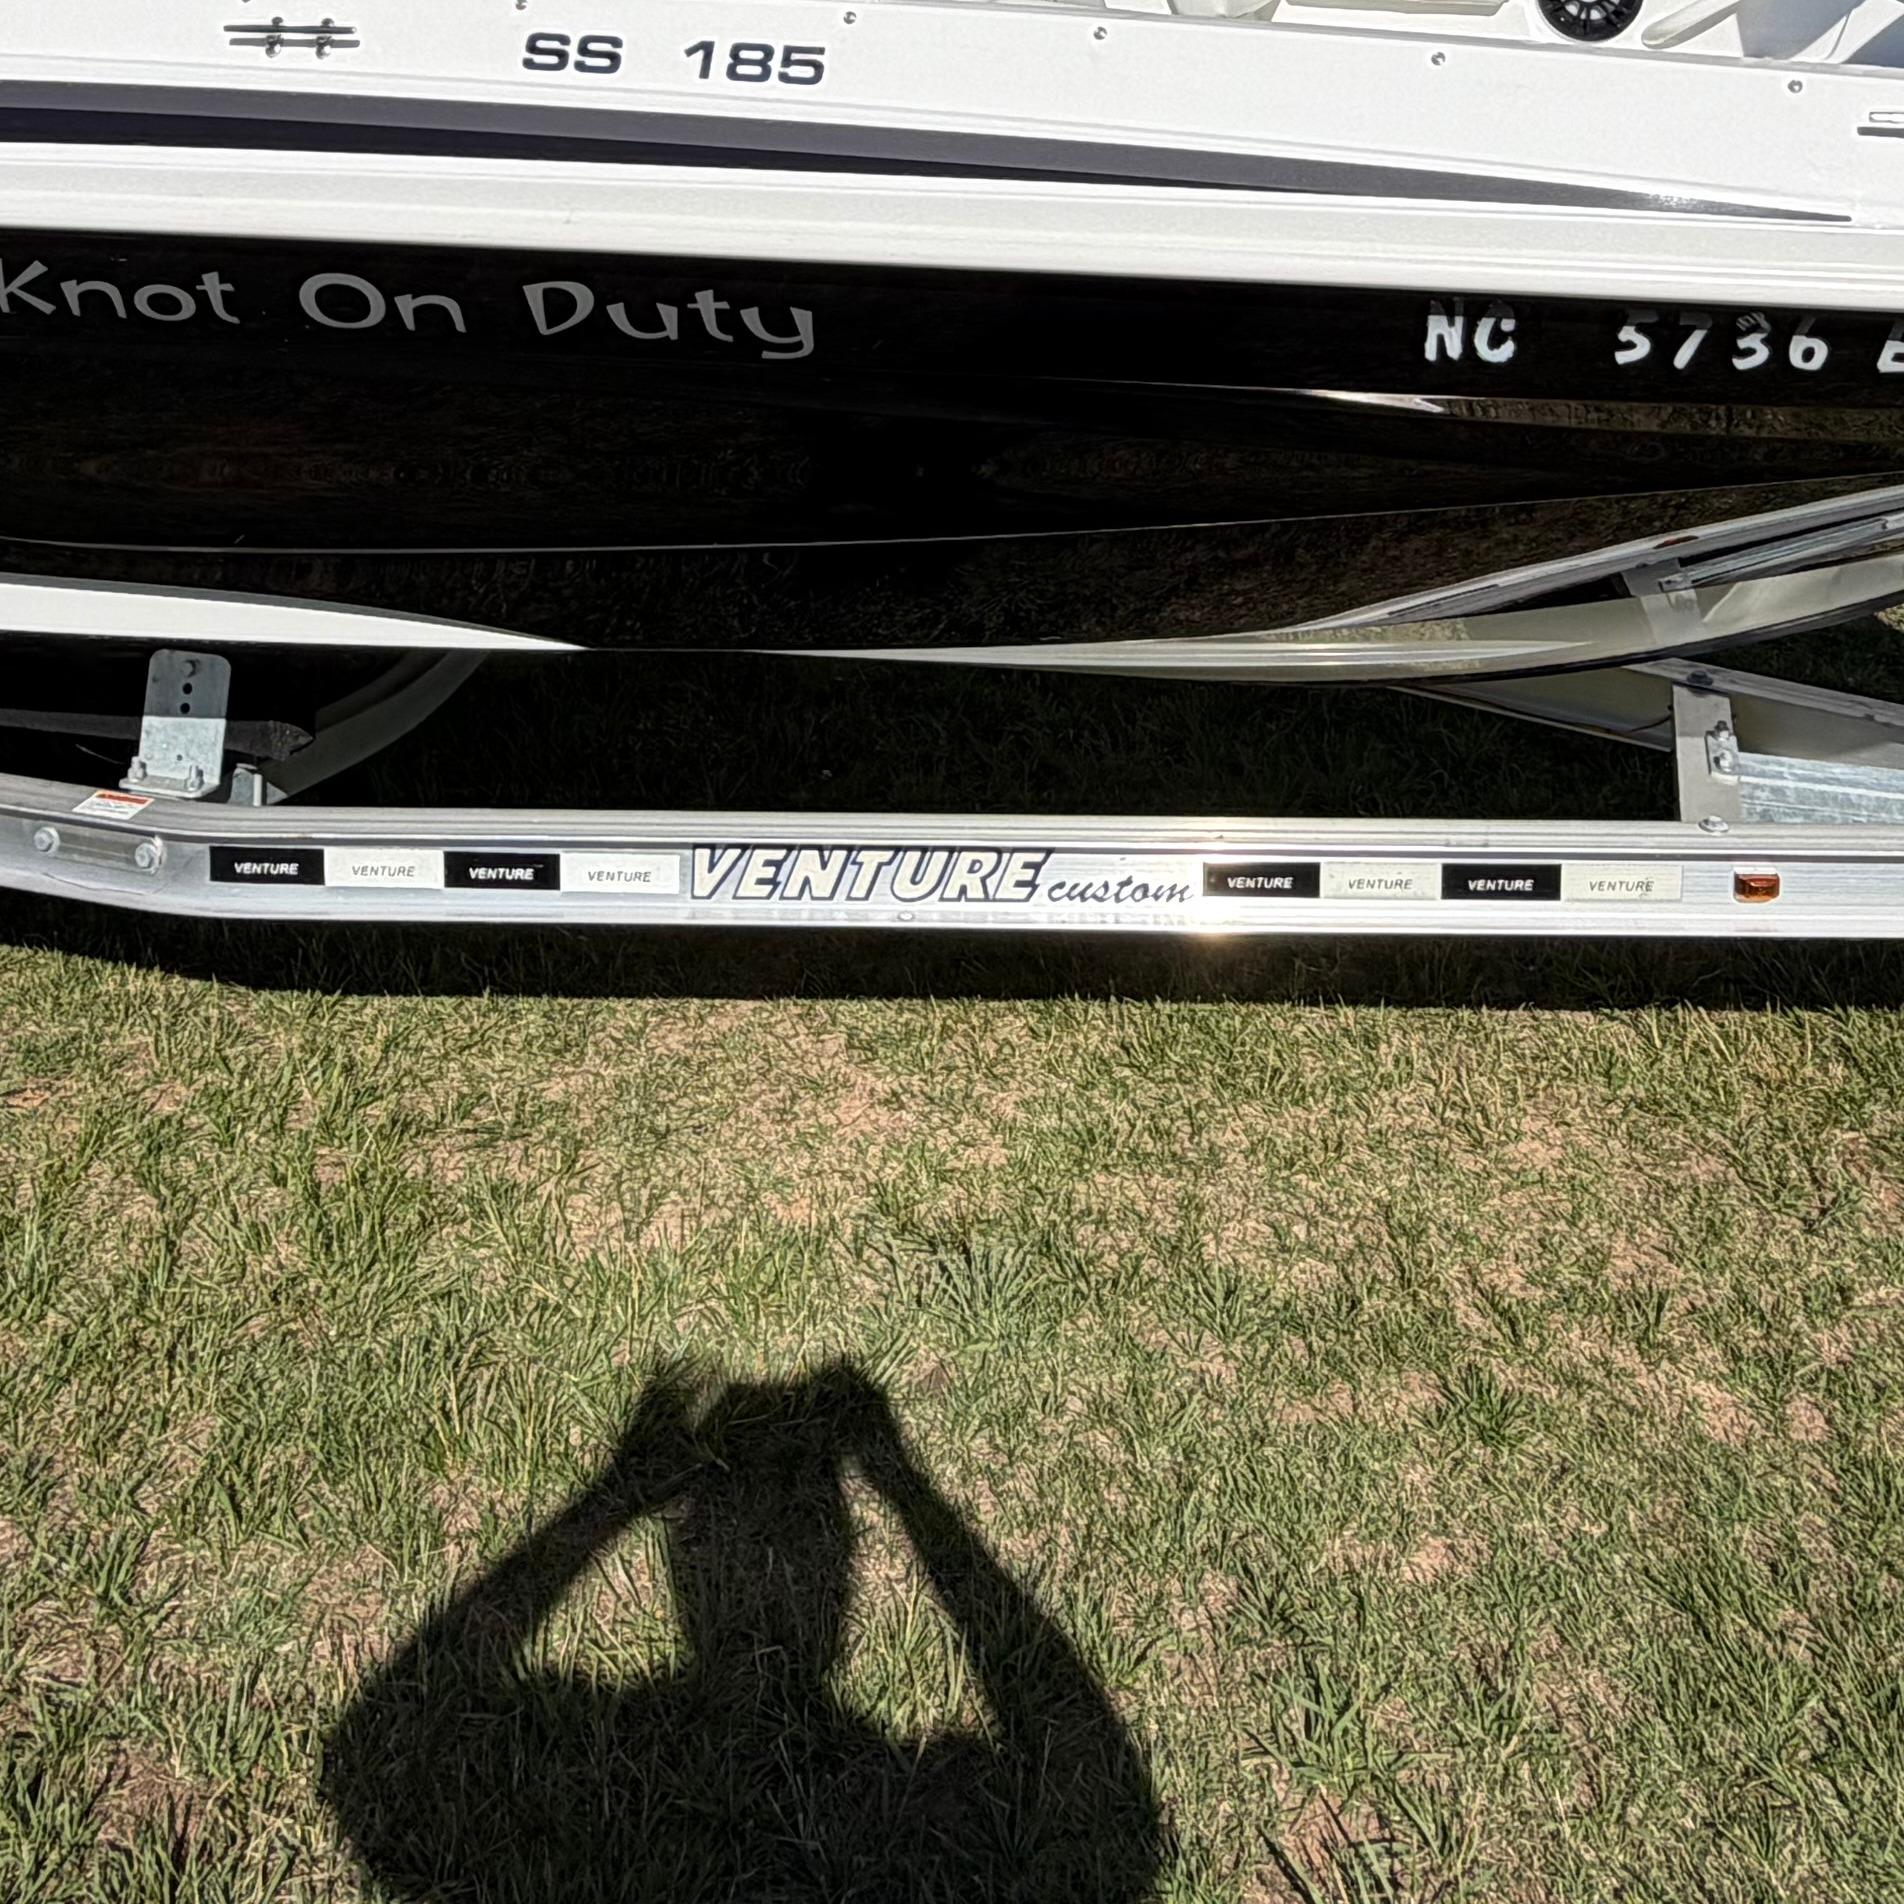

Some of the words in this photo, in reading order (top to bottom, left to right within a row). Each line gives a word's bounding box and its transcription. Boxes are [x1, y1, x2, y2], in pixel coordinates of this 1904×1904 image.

[522, 32, 624, 75] SS
[683, 40, 826, 86] 185
[298, 272, 467, 334] On
[521, 280, 815, 360] Duty
[1424, 296, 1517, 363] NC
[1614, 308, 1830, 371] 5736
[233, 861, 299, 875] VENTURE
[351, 865, 416, 878] VENTURE
[468, 867, 535, 881] VENTURE
[692, 844, 1056, 903] VENTURE
[1046, 874, 1194, 904] custom
[587, 870, 652, 883] VENTURE
[1226, 876, 1294, 889] VENTURE
[1348, 878, 1414, 890] VENTURE
[1467, 878, 1535, 892] VENTURE
[1588, 880, 1656, 893] VENTURE
